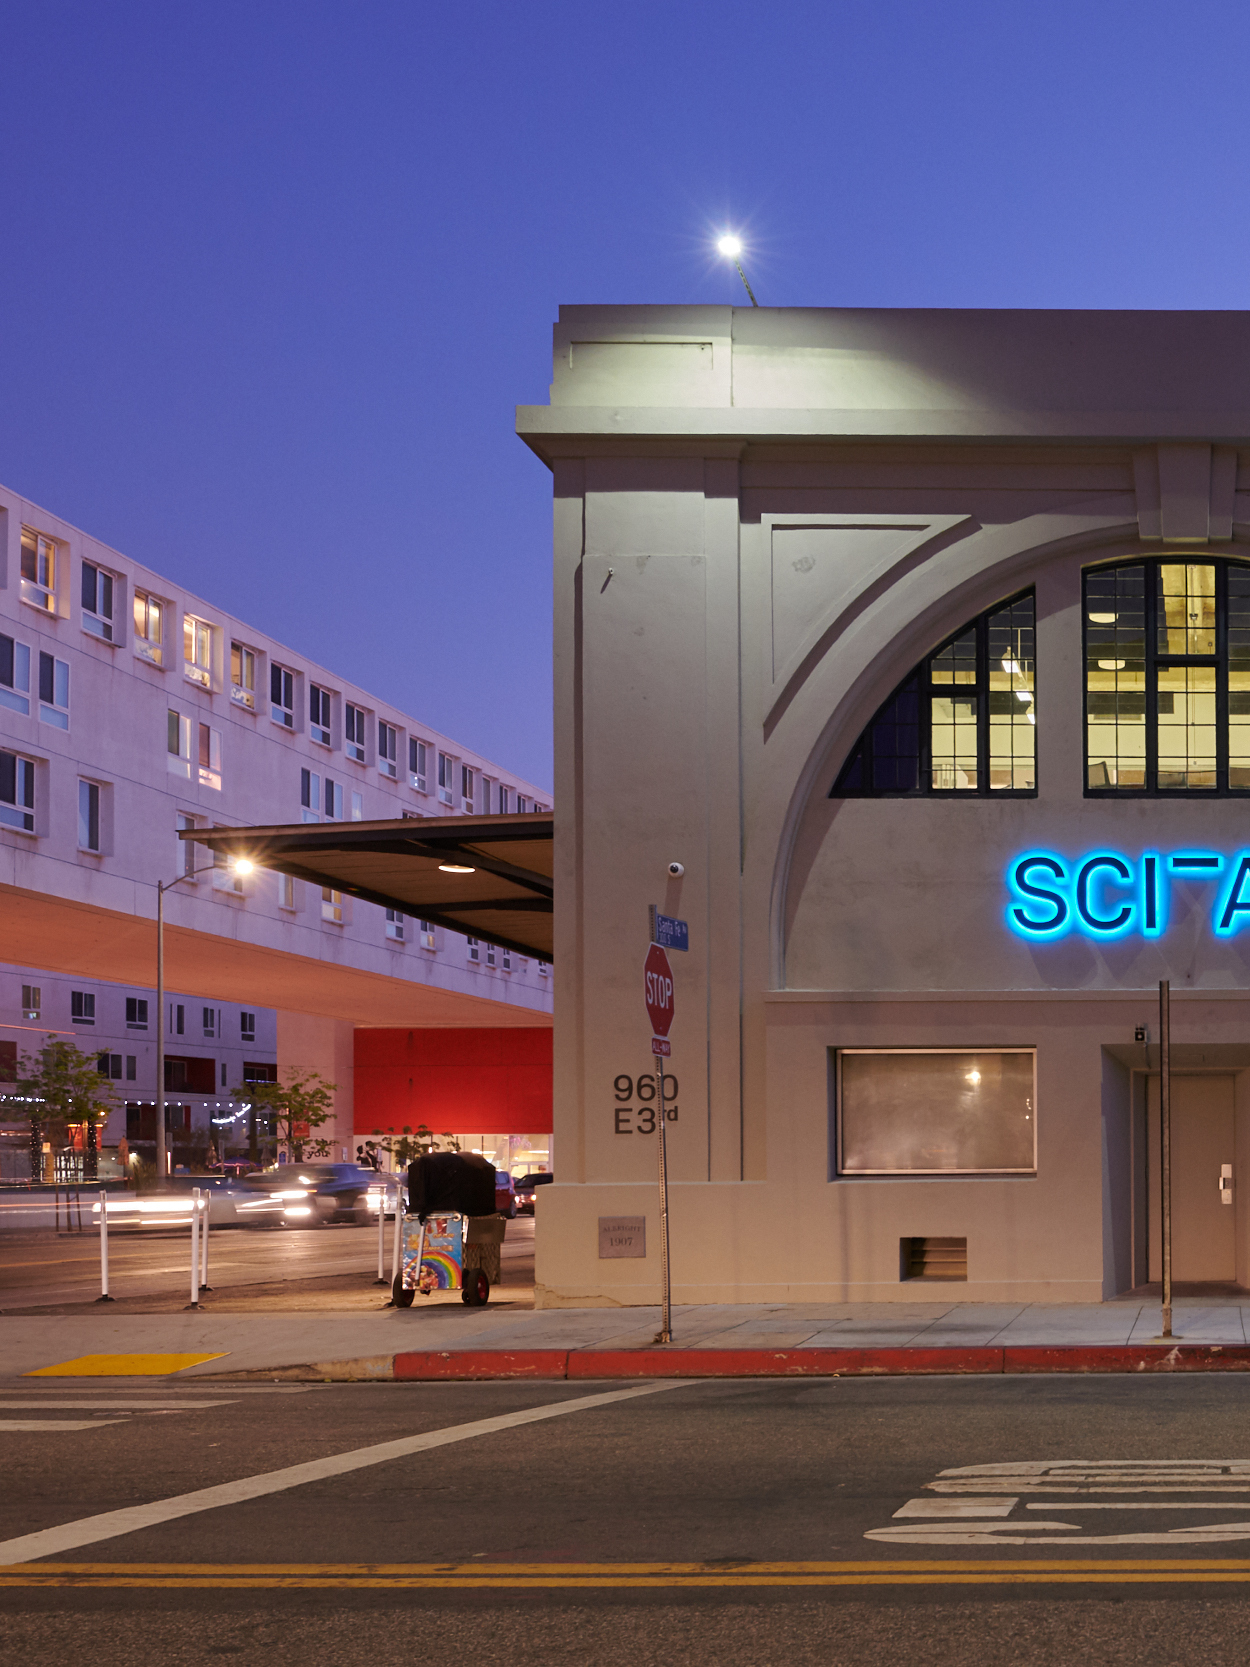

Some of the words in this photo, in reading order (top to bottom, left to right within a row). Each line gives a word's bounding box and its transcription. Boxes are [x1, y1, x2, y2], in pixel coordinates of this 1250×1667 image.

[658, 917, 673, 935] Santa
[674, 921, 681, 937] Fe
[646, 971, 672, 1009] STOP
[614, 1074, 679, 1102] 960
[610, 1237, 633, 1247] 1907
